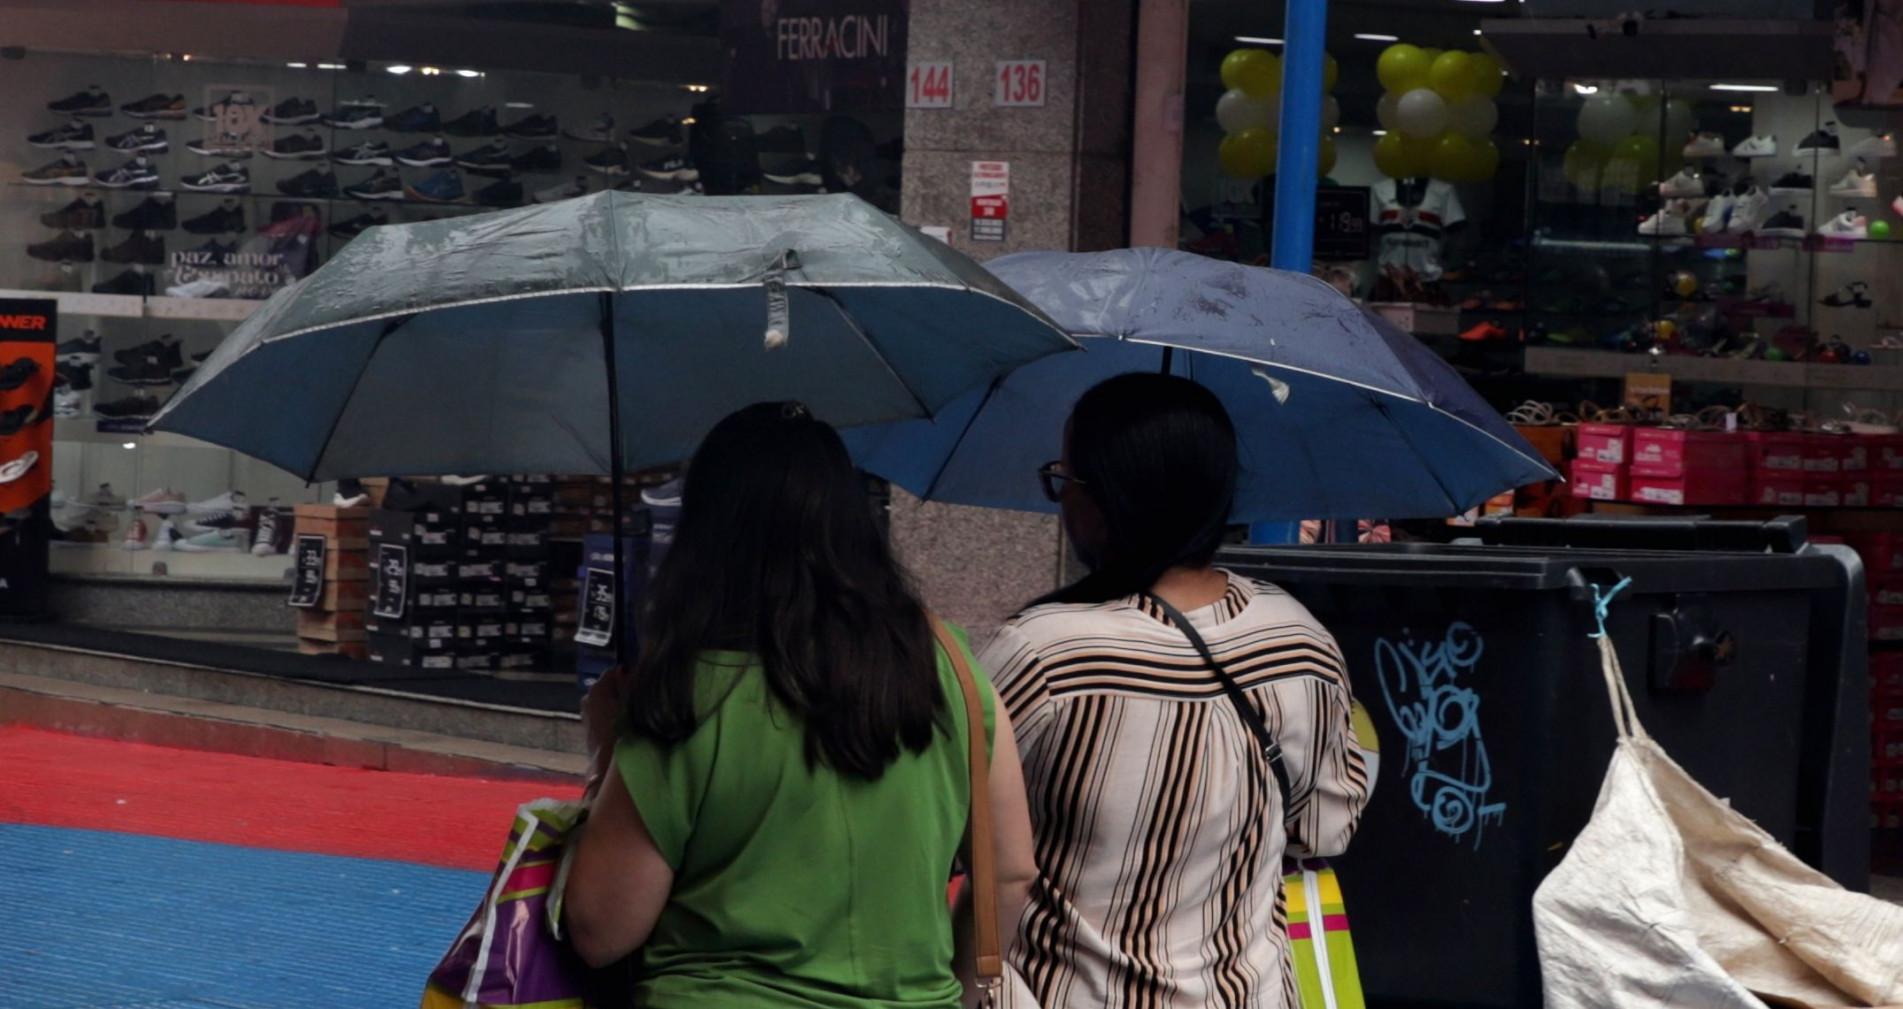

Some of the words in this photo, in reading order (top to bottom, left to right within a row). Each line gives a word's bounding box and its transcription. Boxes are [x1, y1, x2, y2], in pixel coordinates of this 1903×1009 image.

[778, 14, 888, 60] FERRACINI
[910, 66, 949, 103] 144
[1001, 64, 1040, 102] 136
[223, 251, 284, 266] amor
